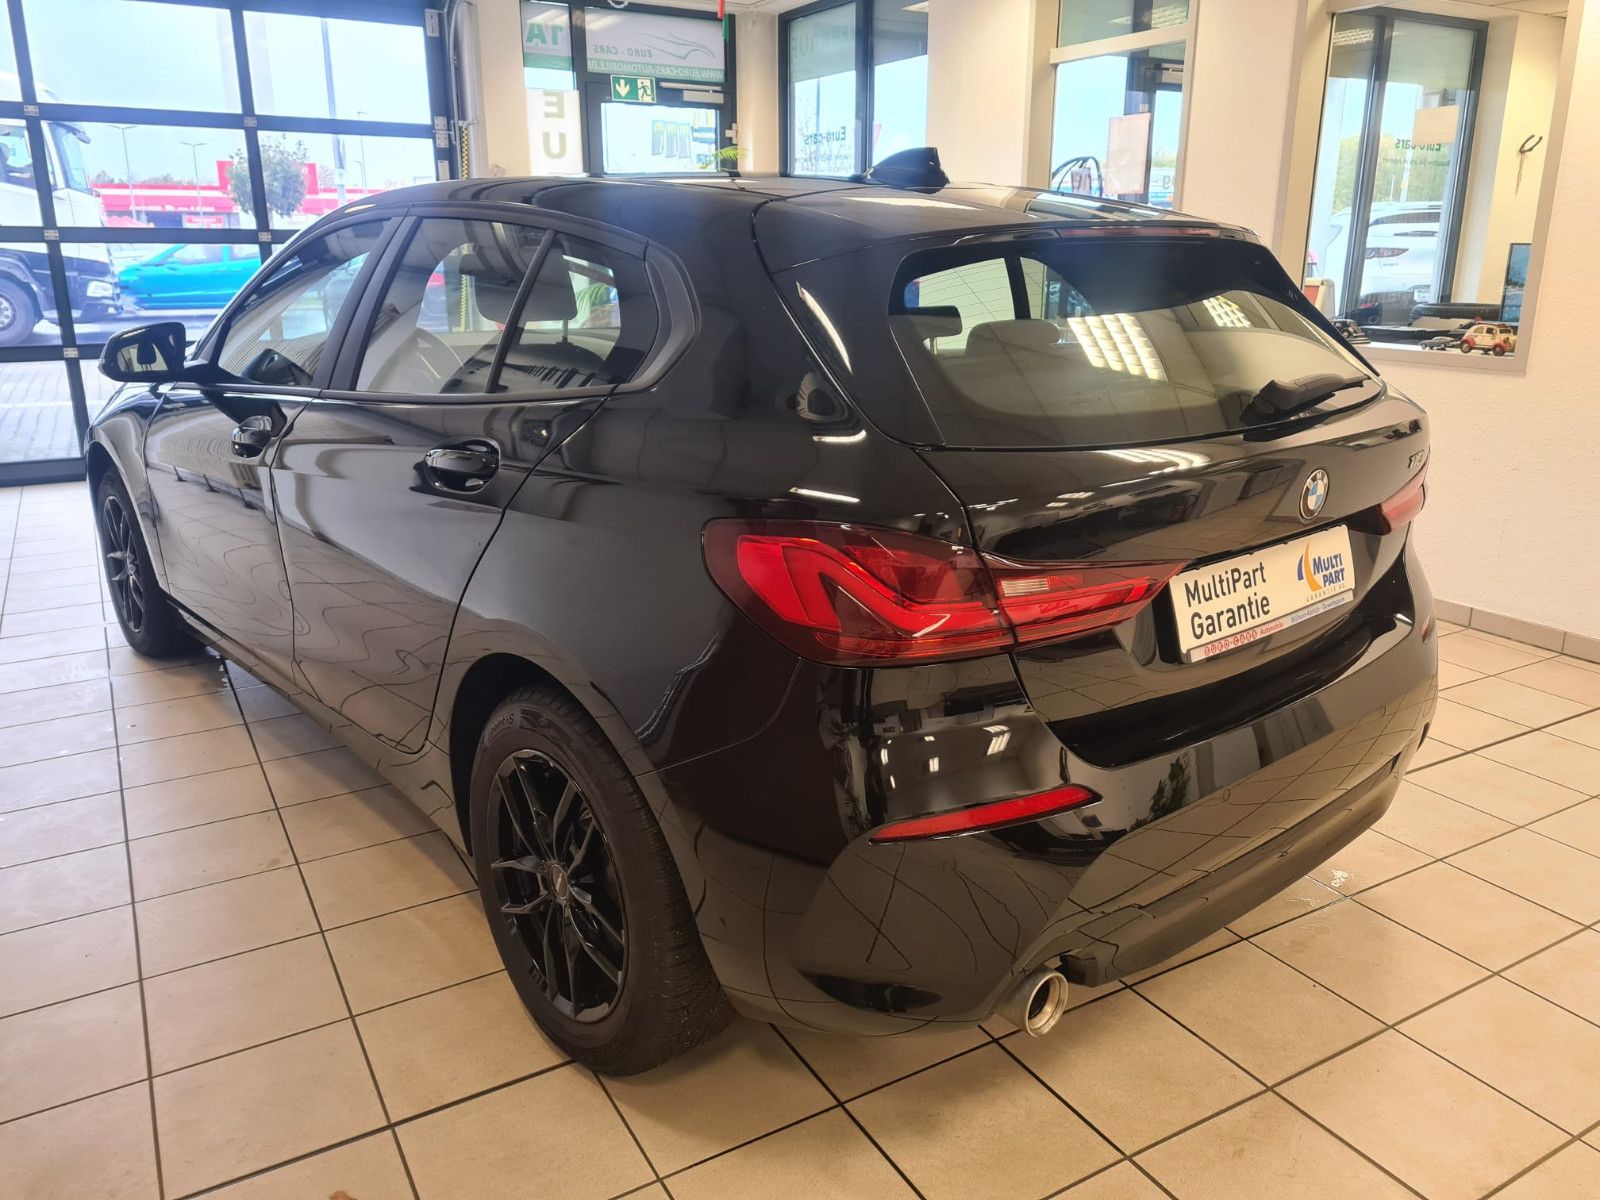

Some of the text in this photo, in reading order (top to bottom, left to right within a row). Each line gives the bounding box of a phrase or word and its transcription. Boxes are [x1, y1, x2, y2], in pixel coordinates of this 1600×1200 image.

[1313, 553, 1343, 576] MULTI
[1184, 562, 1267, 608] MultiPart
[1322, 567, 1345, 588] PART
[1306, 586, 1336, 602] GARANTIE
[1190, 591, 1270, 640] Garantie
